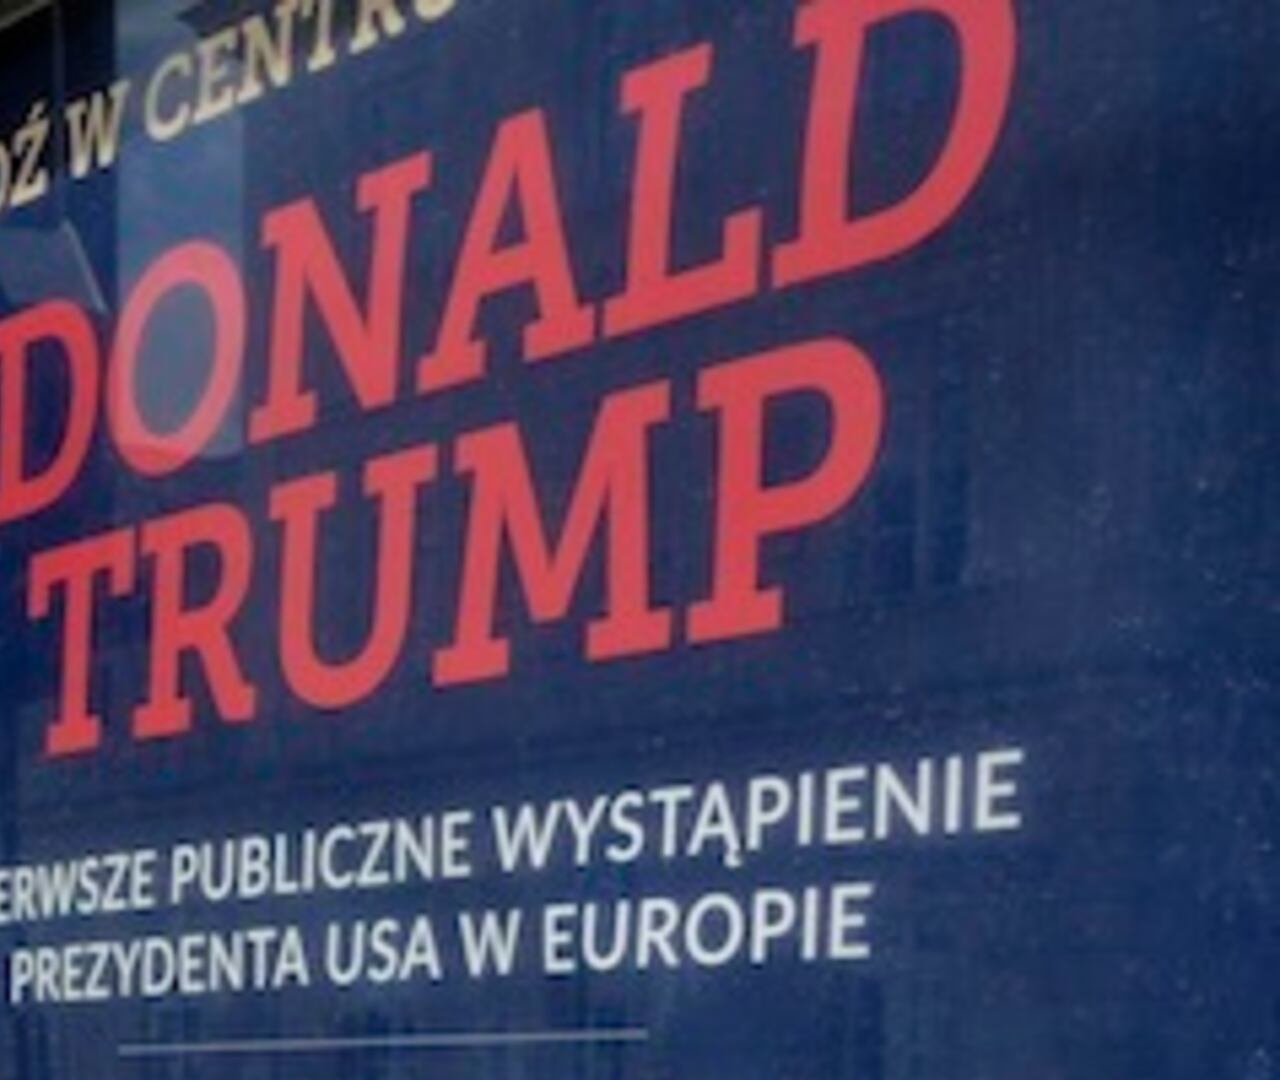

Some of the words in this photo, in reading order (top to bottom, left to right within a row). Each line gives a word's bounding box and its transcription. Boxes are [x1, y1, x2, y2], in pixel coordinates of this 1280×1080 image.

[63, 80, 127, 178] W
[27, 337, 886, 757] TRUMP
[169, 810, 473, 905] PUBLICZNE
[491, 748, 1025, 872] WYSTĄPIENIE
[9, 926, 310, 1003] PREZYDENTA
[324, 915, 442, 986] USA
[458, 908, 522, 977] W
[542, 882, 874, 973] EUROPIE
